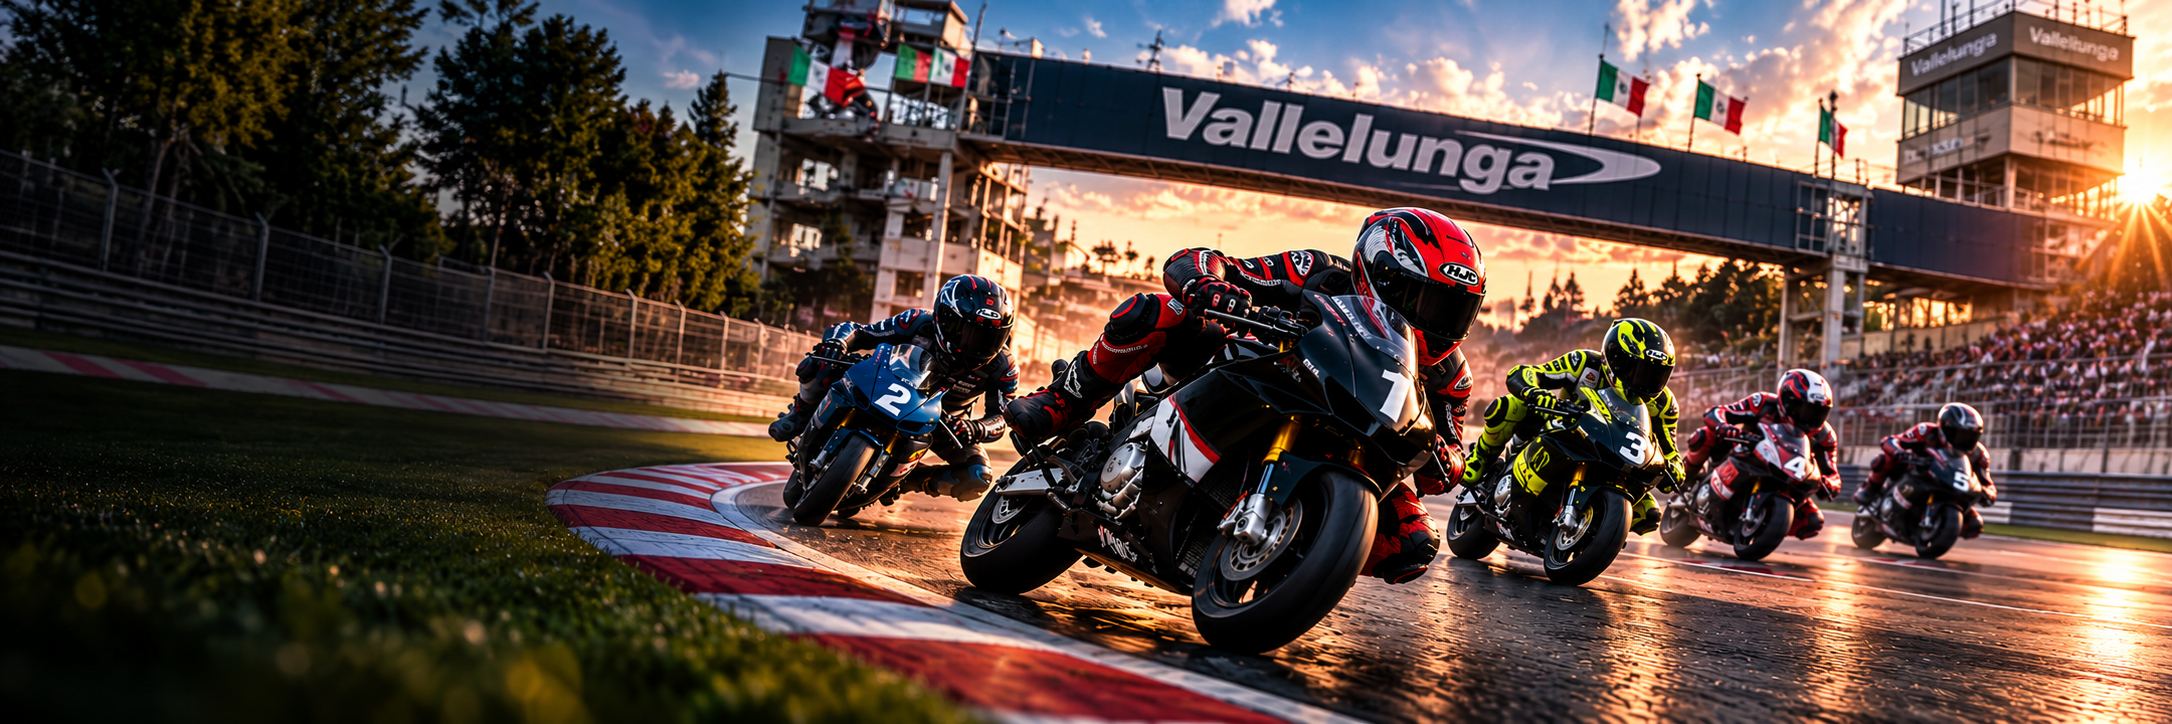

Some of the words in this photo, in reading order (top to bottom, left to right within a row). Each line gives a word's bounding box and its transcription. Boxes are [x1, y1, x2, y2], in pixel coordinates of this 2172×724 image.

[1910, 32, 1998, 77] Vallelunga
[1162, 86, 1556, 195] Vallelunga
[1447, 265, 1476, 282] HJC
[874, 382, 911, 417] 2
[1618, 431, 1648, 466] 3
[1784, 456, 1806, 479] 4
[1953, 471, 1970, 492] 5
